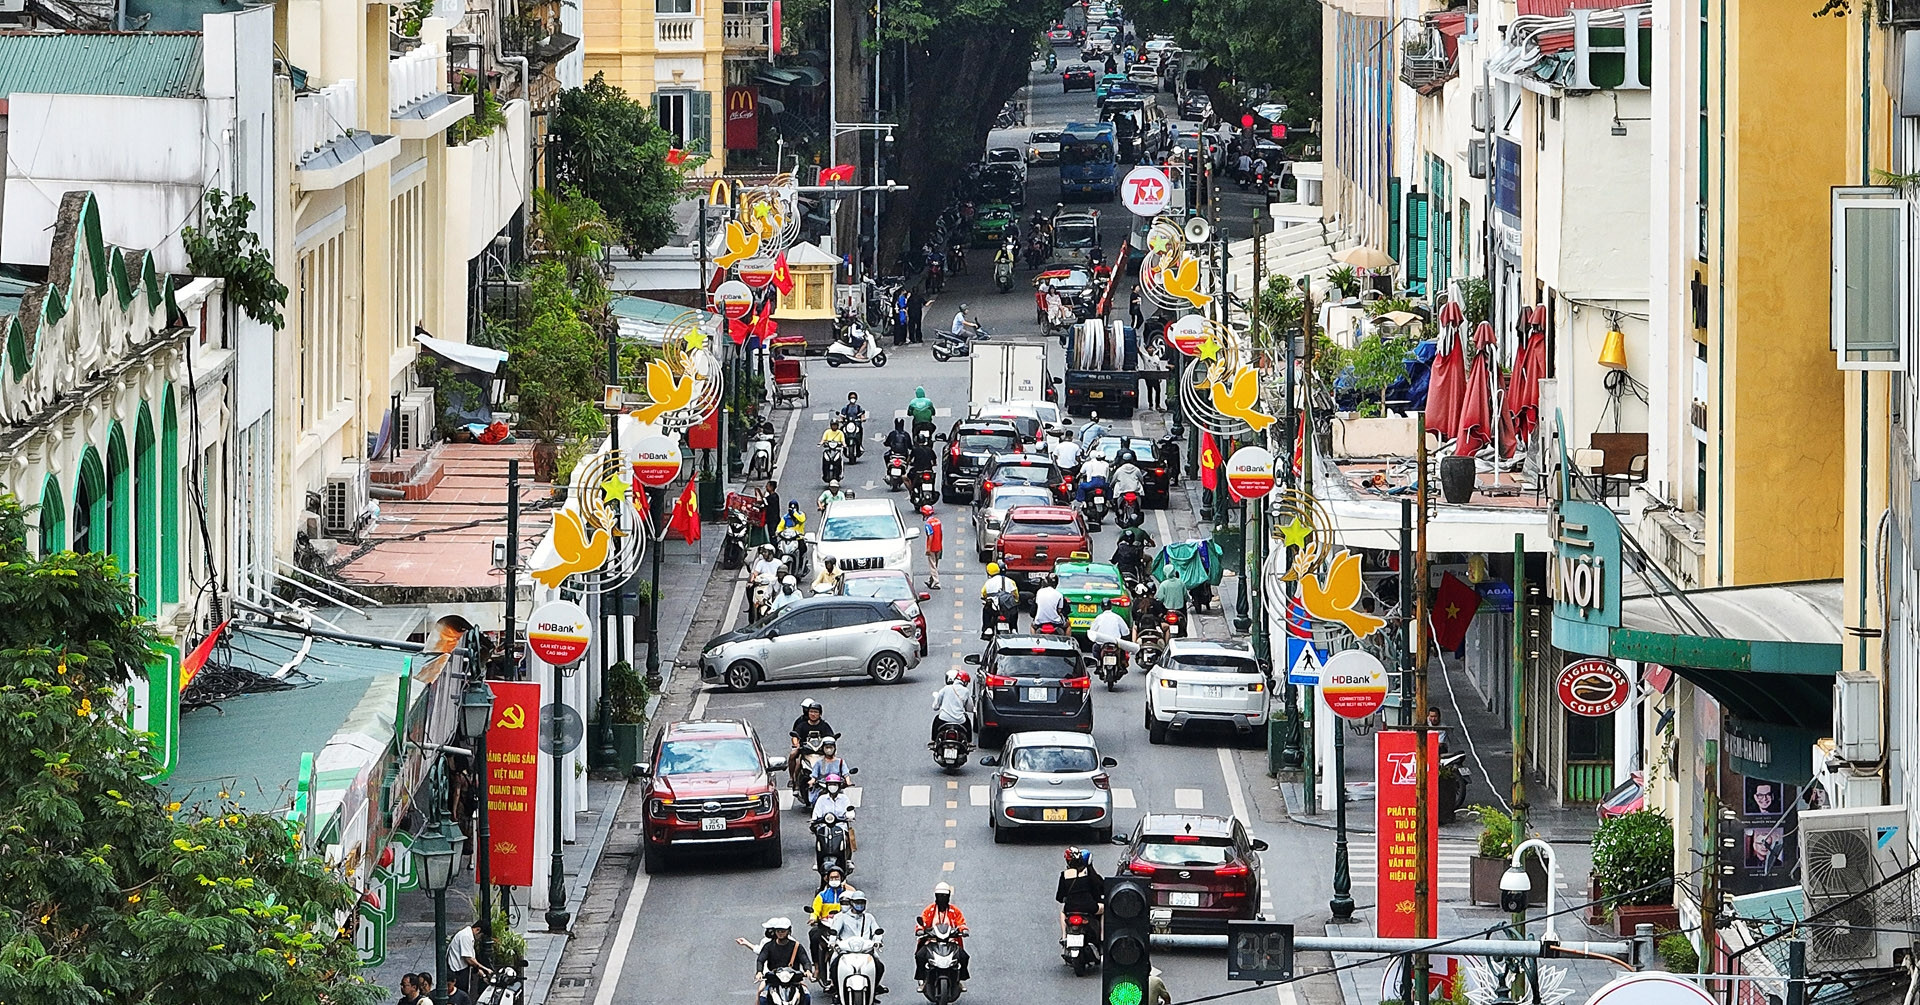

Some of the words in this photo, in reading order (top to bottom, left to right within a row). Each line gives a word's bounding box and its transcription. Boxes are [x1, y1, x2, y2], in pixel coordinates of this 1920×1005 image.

[638, 452, 668, 460] HDBank
[538, 623, 575, 633] HDBank
[1561, 660, 1627, 687] HIGHLANDS
[1332, 676, 1370, 684] HDBank
[1568, 699, 1620, 715] COFFEE
[502, 753, 520, 765] CỘNG
[521, 751, 535, 764] SẢN
[494, 768, 507, 781] VIỆT
[508, 770, 524, 780] NAM
[489, 785, 511, 796] QUANG
[512, 786, 527, 796] VINH
[508, 800, 524, 812] NĂM
[1387, 806, 1406, 816] PHÁT
[1395, 818, 1408, 829] THỦ
[1395, 831, 1405, 842] HÀ
[1389, 844, 1404, 855] VĂN
[1388, 857, 1404, 867] VĂN
[1389, 870, 1406, 883] HIỆN
